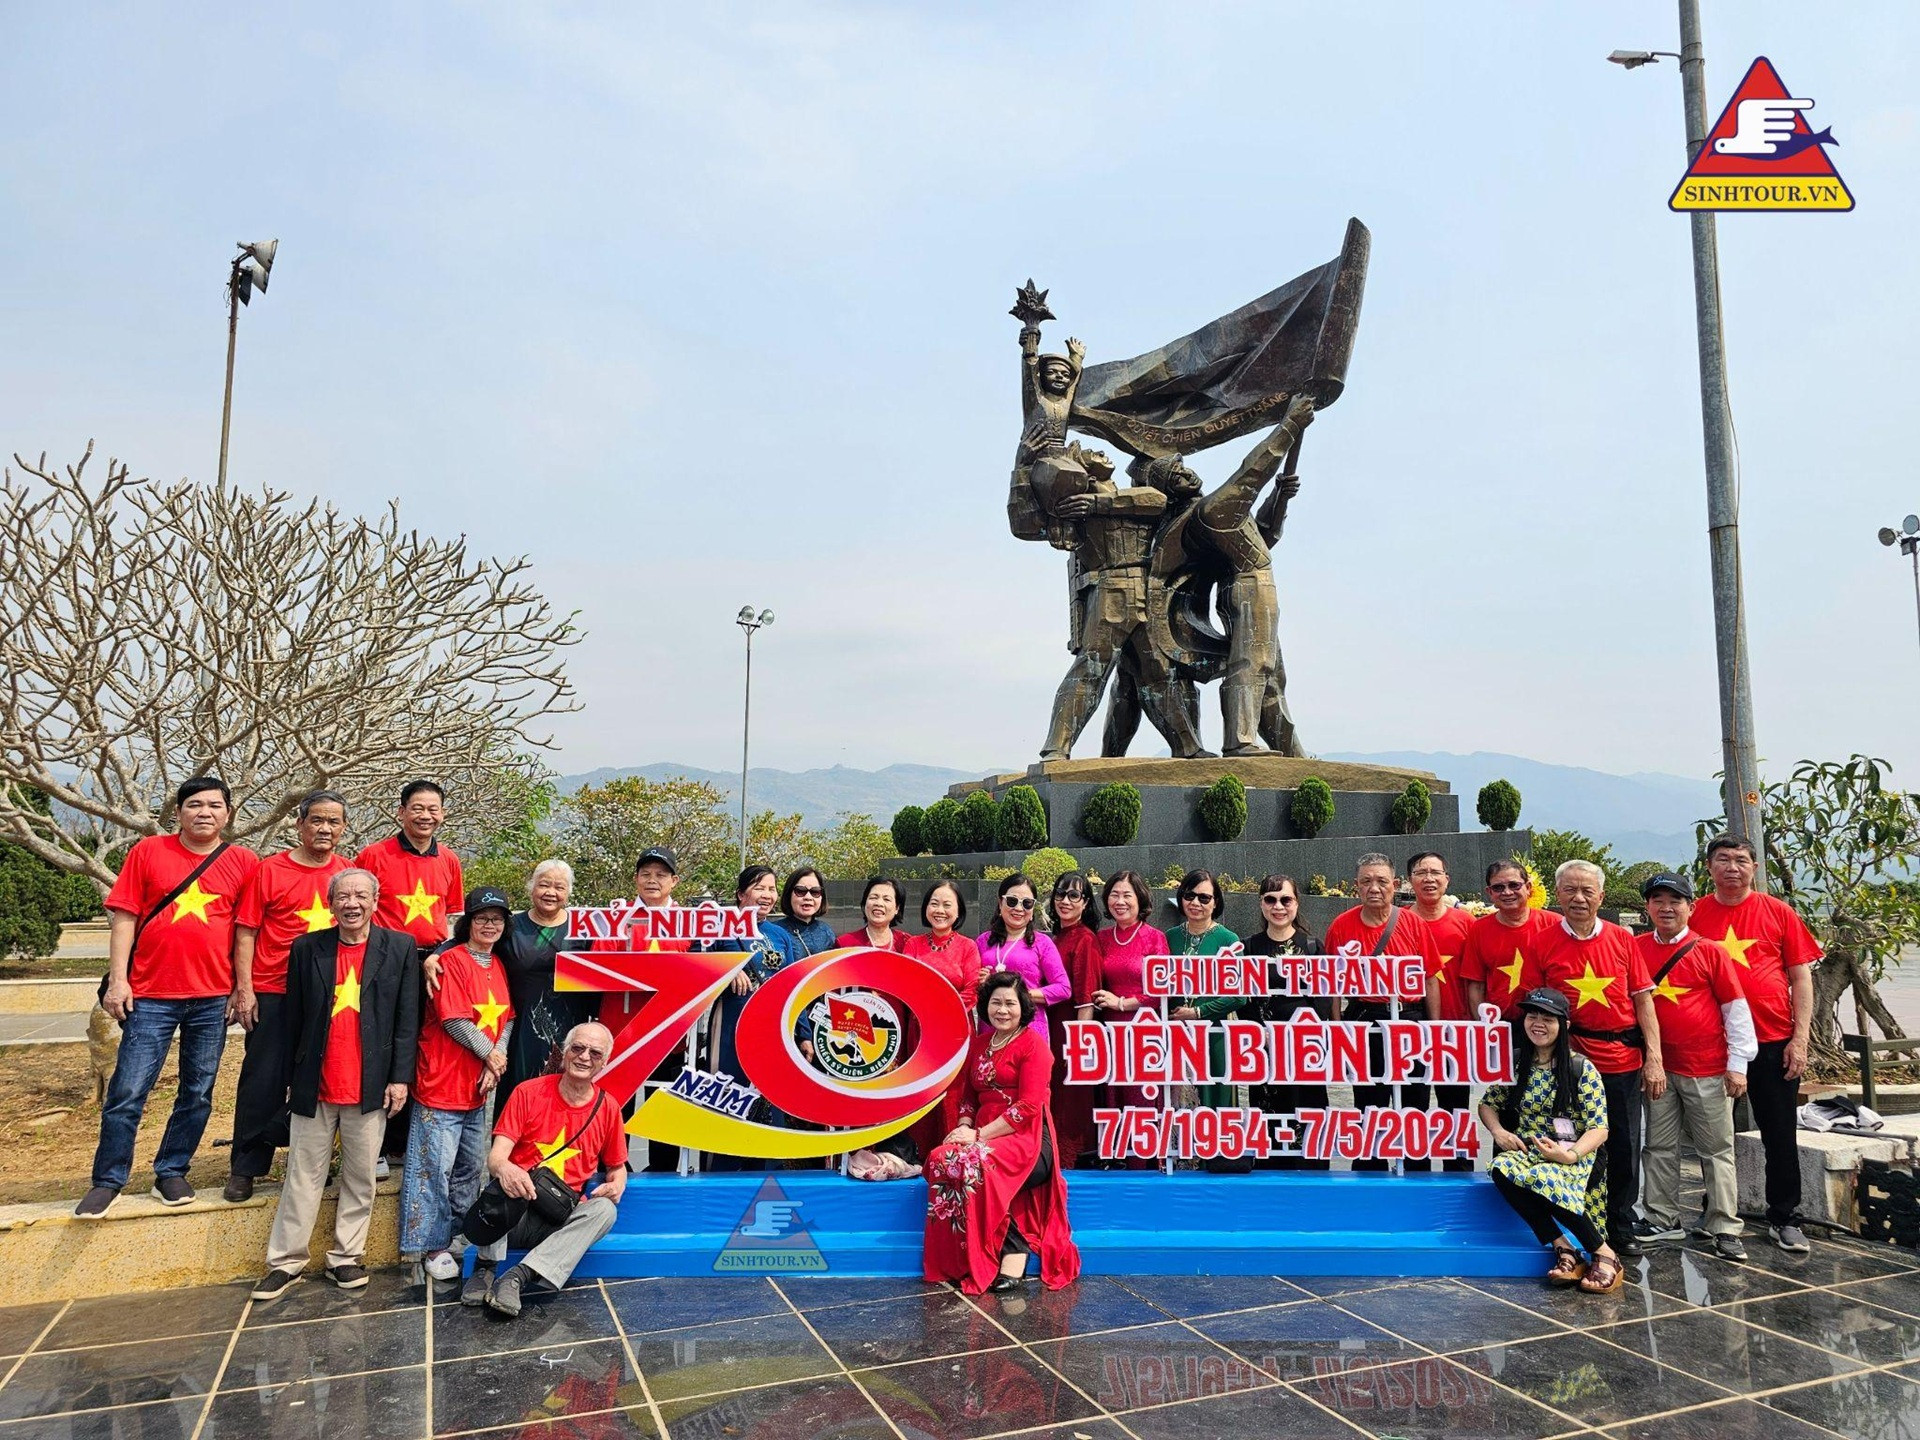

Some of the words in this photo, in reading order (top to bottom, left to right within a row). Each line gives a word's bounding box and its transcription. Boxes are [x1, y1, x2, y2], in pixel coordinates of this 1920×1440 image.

[566, 900, 629, 938] KỶ
[648, 902, 758, 946] NIỆM
[1144, 941, 1270, 996] CHIẾN
[1280, 941, 1426, 996] THẮNG
[1063, 1007, 1213, 1100] ĐIỆN
[1224, 1007, 1374, 1085] BIÊN
[1380, 1004, 1516, 1085] PHỦ
[669, 1068, 757, 1118] NĂM
[1095, 1107, 1271, 1159] 7/5/1954
[1299, 1107, 1481, 1159] 7/5/2024
